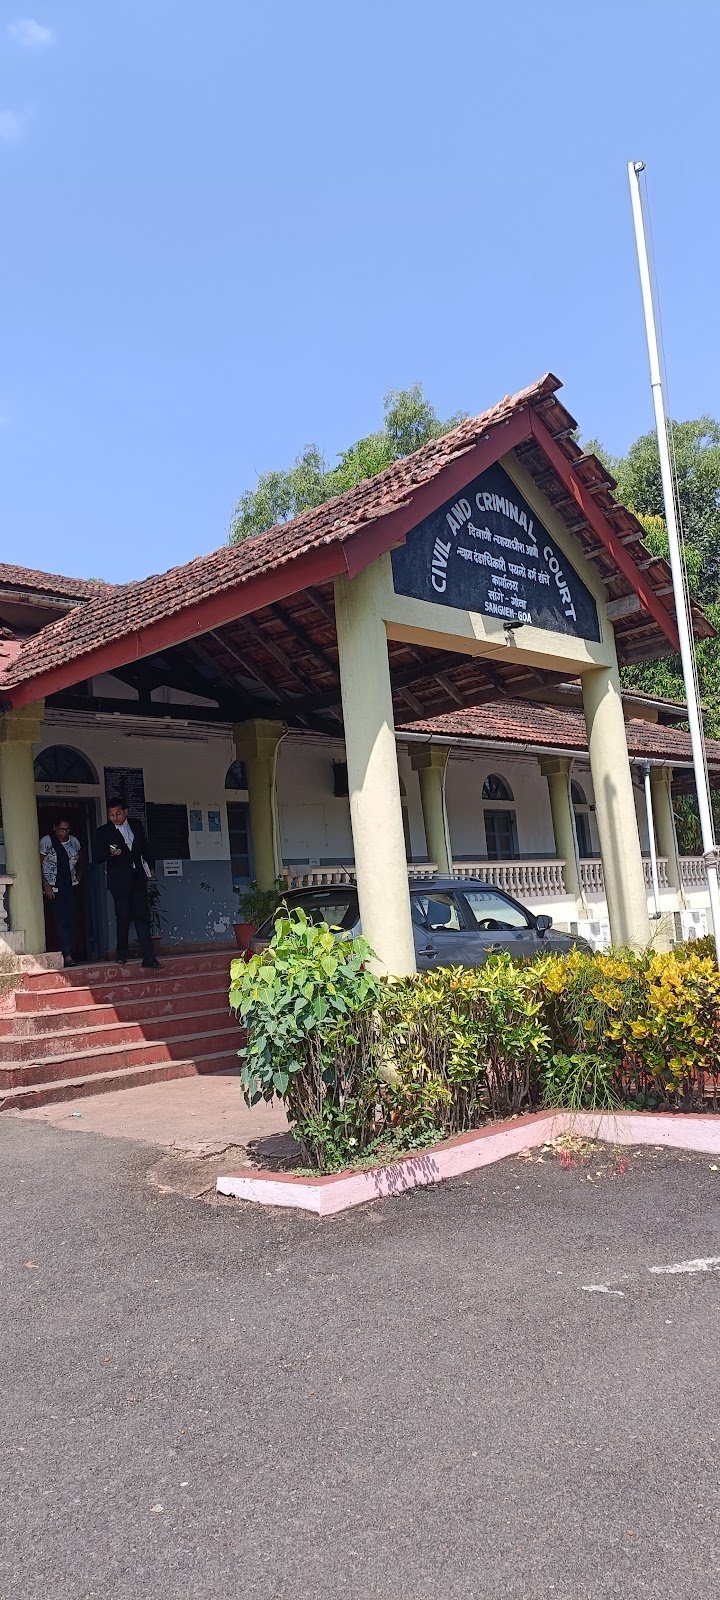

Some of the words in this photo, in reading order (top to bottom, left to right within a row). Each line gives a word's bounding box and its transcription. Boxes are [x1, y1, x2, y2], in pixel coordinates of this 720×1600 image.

[431, 537, 451, 593] CIVIL
[445, 498, 472, 537] AND
[475, 492, 537, 543] CRIMINAL
[543, 546, 577, 622] COURT
[491, 573, 519, 592] कार्यालय
[44, 784, 50, 793] 2
